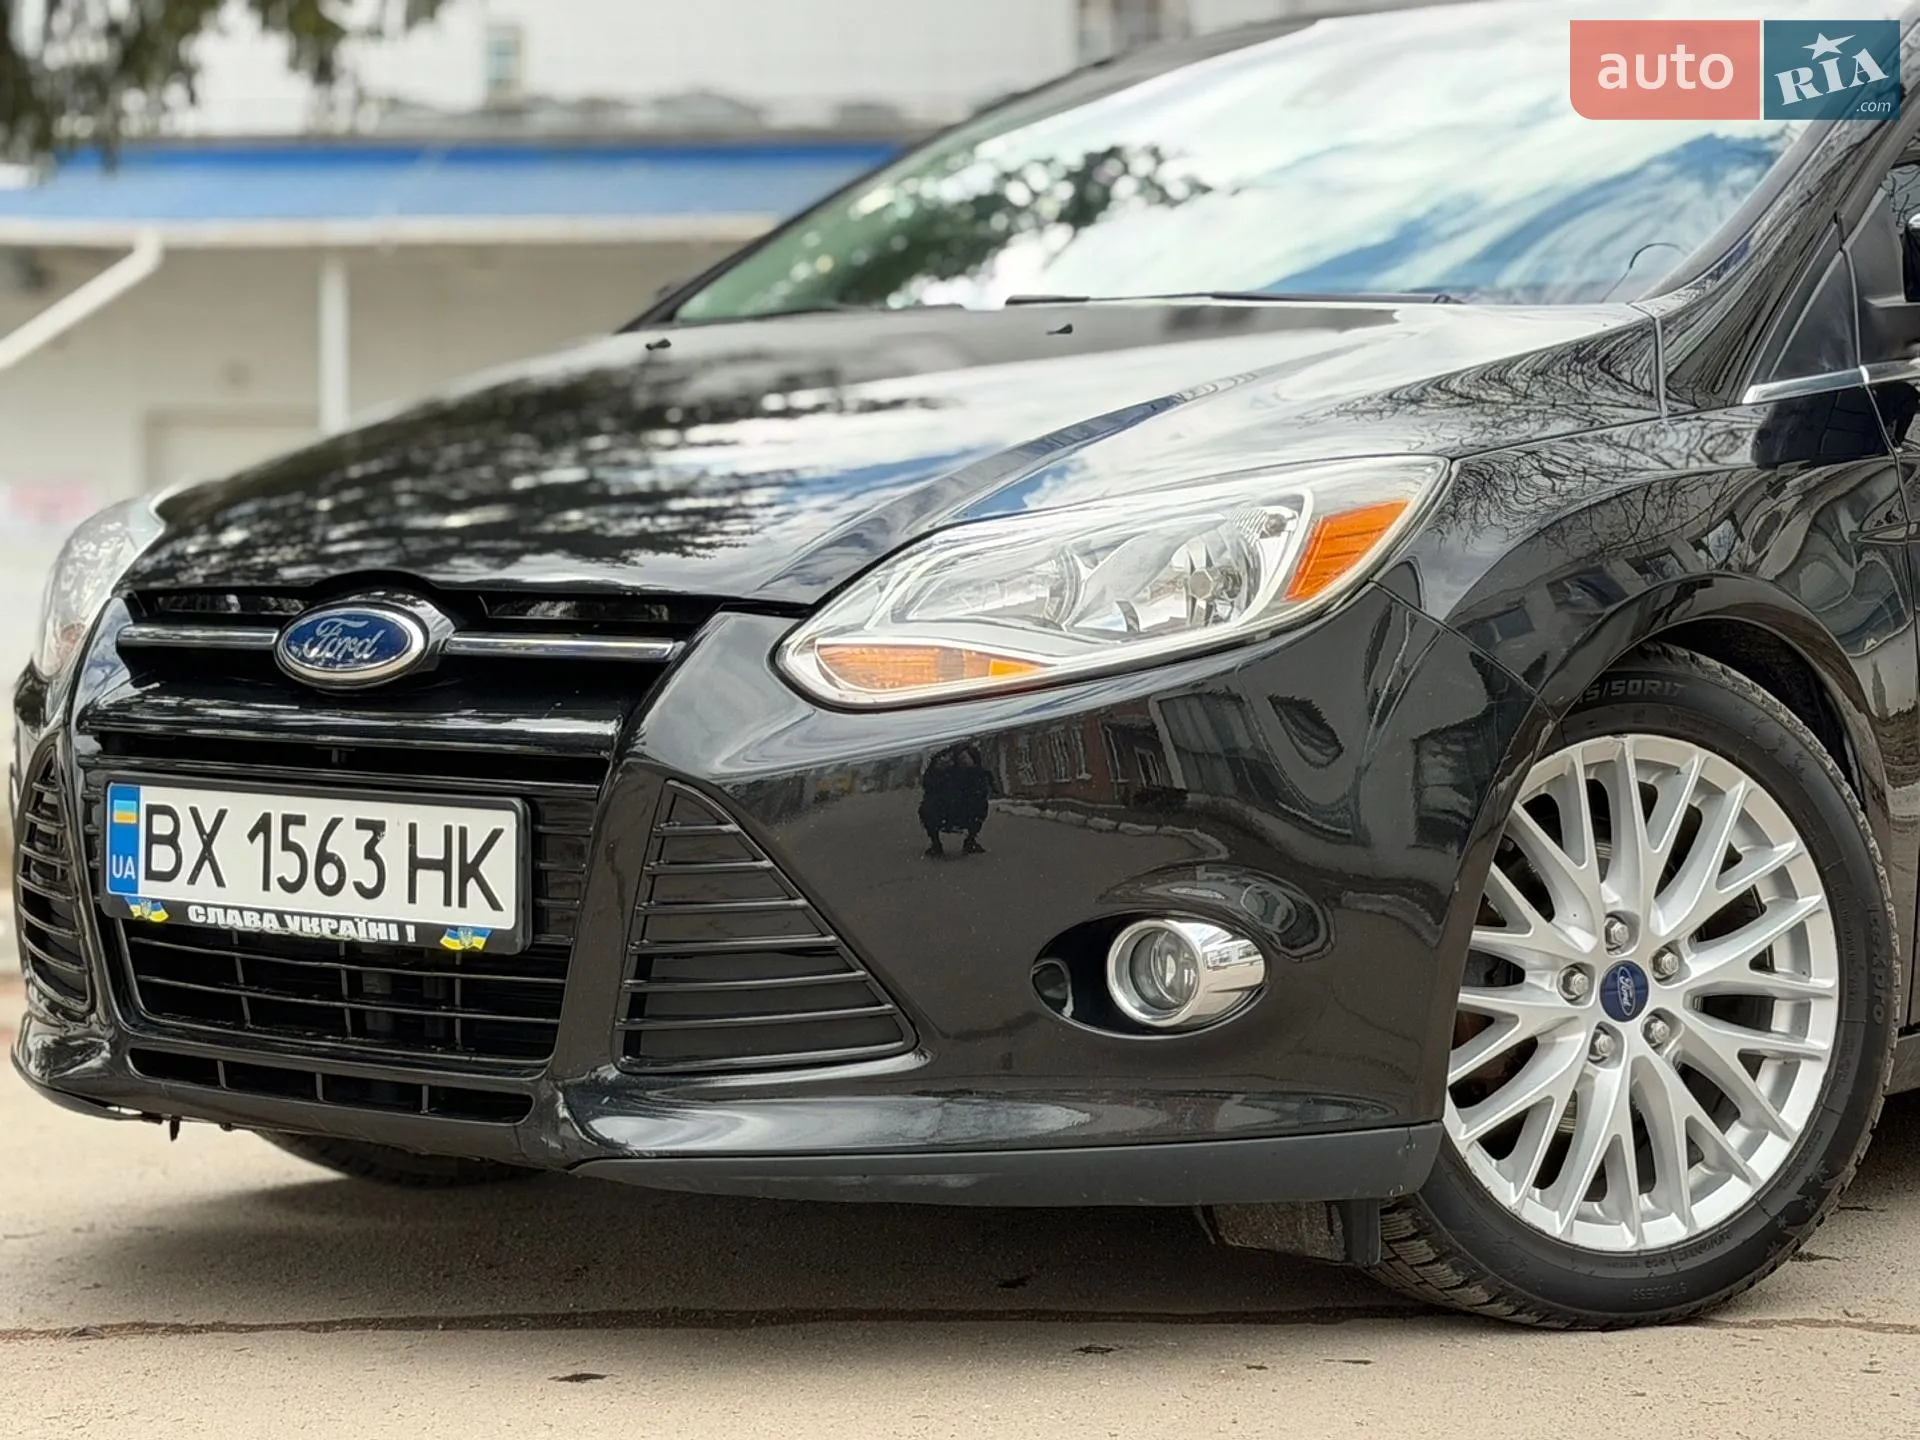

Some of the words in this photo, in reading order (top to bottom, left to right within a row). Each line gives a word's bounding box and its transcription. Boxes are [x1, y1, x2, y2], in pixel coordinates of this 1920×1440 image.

[302, 617, 386, 661] Ford
[112, 854, 136, 881] UA
[144, 803, 229, 888] BX
[246, 812, 387, 900] 1563
[407, 821, 505, 912] HK
[187, 905, 279, 930] СЛАВА
